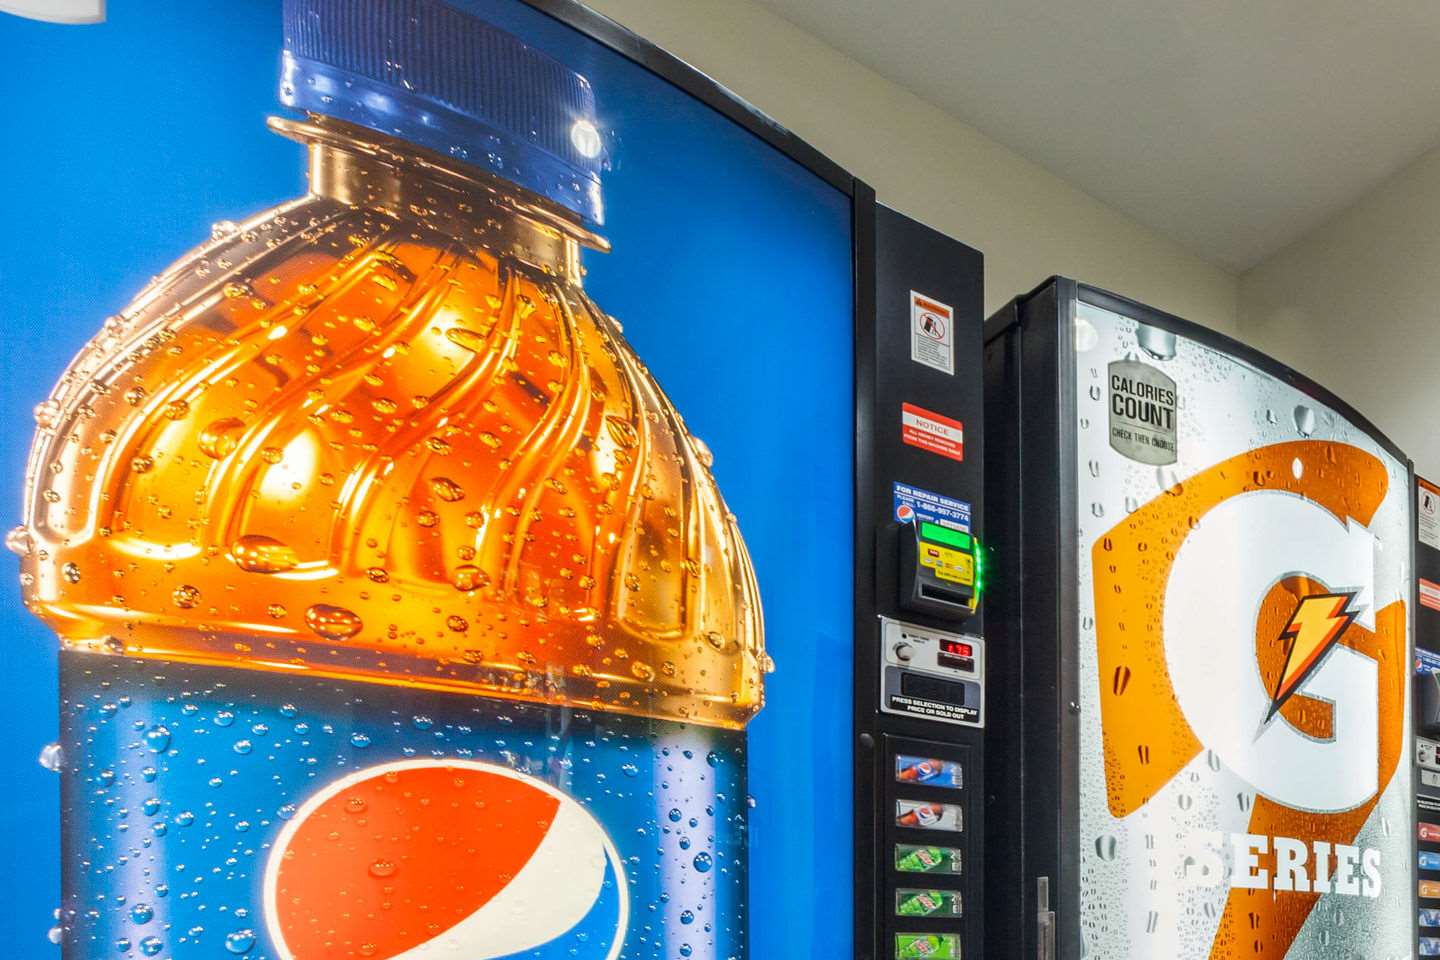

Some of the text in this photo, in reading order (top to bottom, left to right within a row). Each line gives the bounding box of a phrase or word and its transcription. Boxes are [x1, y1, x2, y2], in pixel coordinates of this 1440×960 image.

[1111, 375, 1174, 406] CALORIES
[1112, 394, 1174, 429] COUNT
[916, 418, 949, 435] NOTICE
[1112, 427, 1132, 440] CHECK
[1135, 433, 1150, 445] THEN
[896, 485, 969, 511] FOR REPAIR SERVICE
[1162, 489, 1379, 815] G
[892, 696, 912, 704] PRESS
[913, 699, 946, 710] SELECTION
[954, 706, 978, 715] DISPLAY
[907, 705, 925, 713] PRICE
[1181, 831, 1382, 898] SERIES
